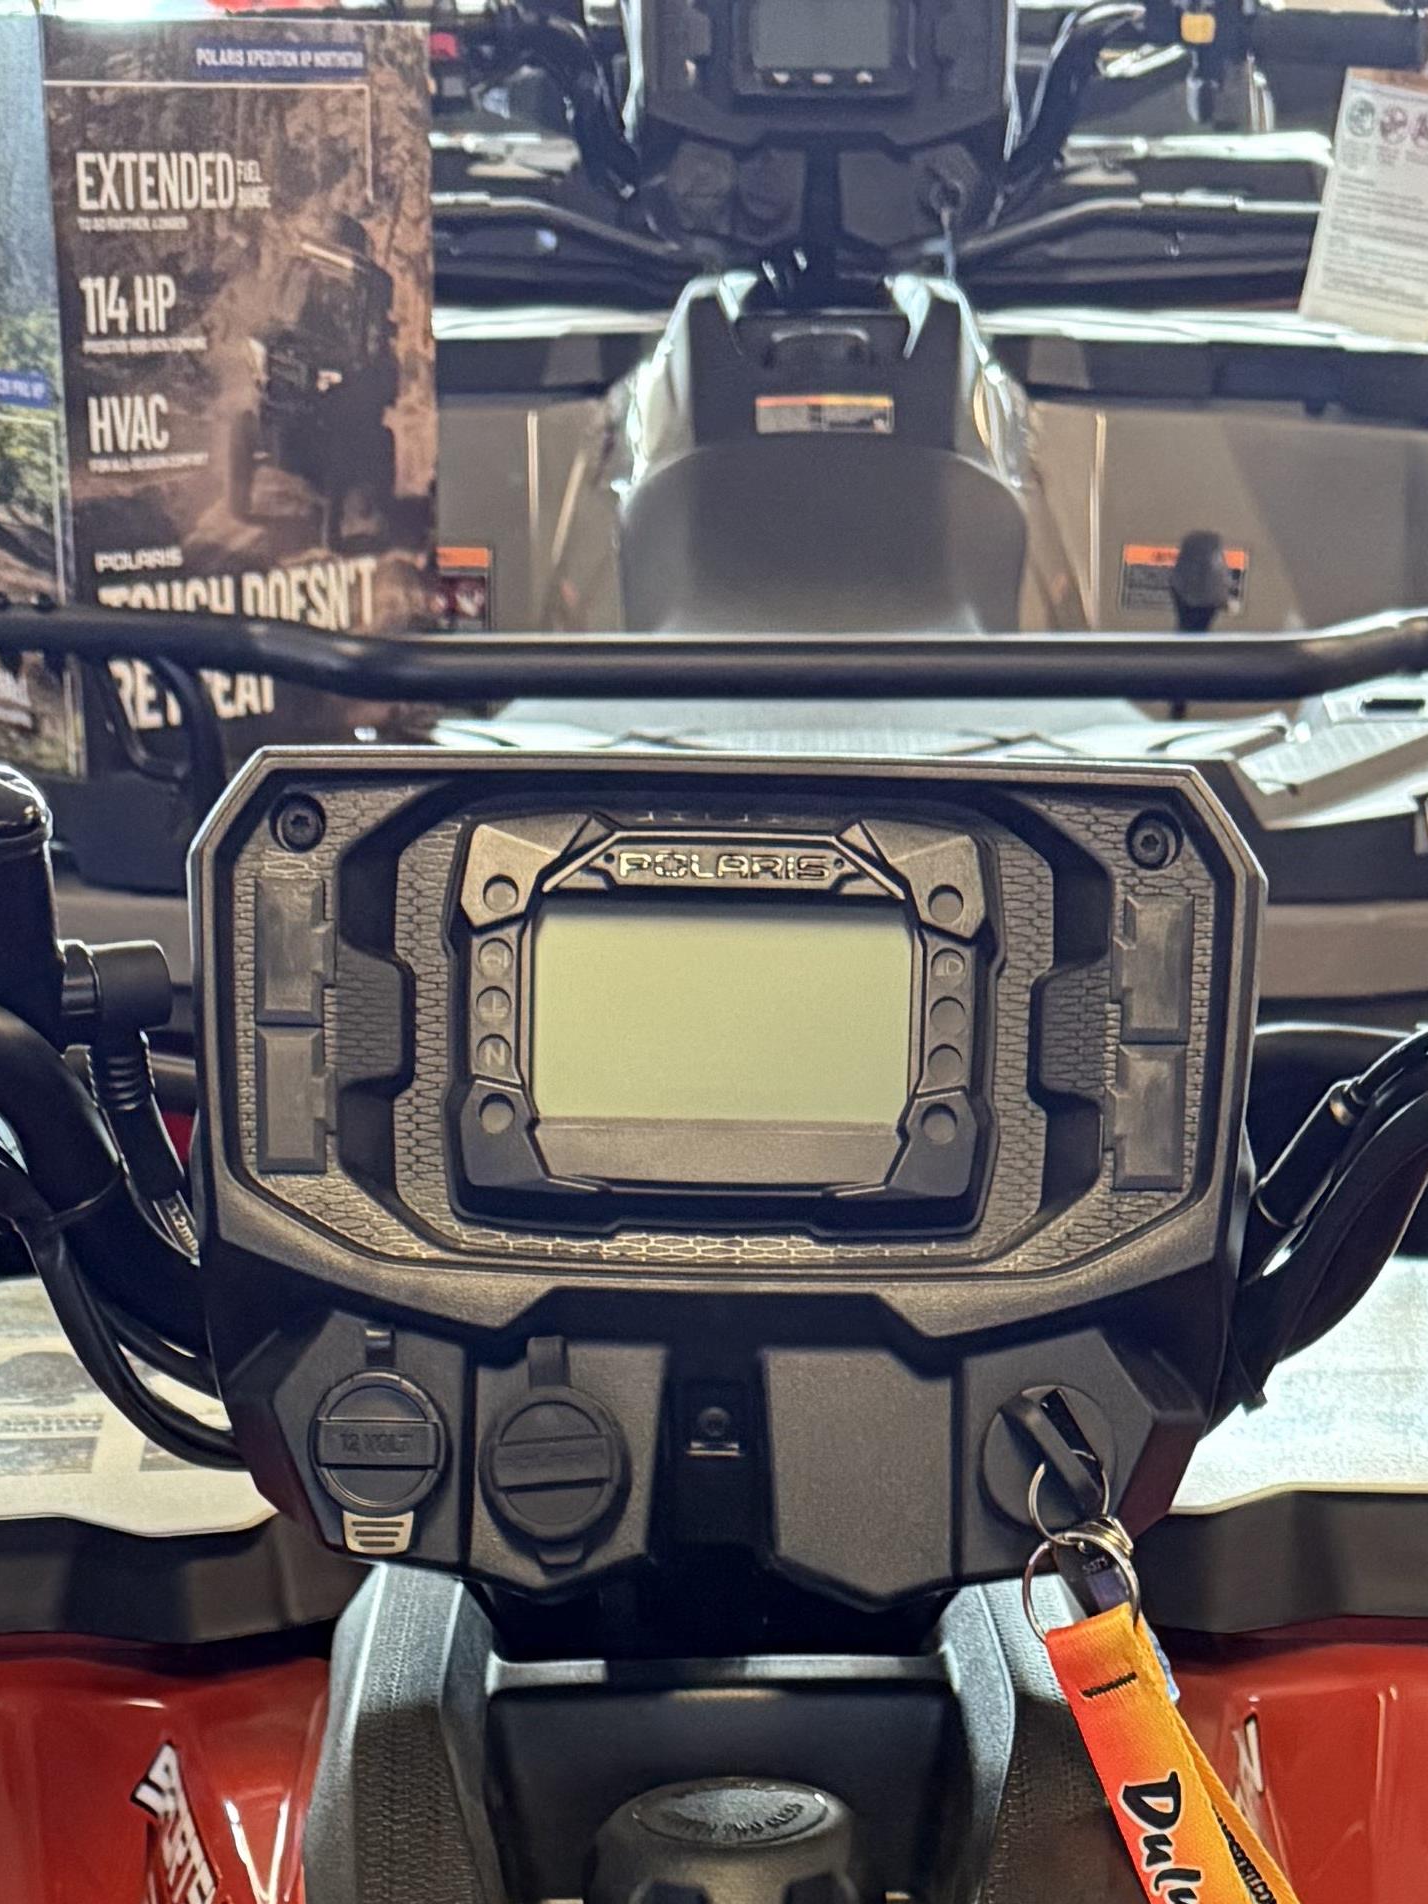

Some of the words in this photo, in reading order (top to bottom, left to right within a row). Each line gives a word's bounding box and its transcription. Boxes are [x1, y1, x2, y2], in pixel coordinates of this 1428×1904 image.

[76, 152, 236, 211] EXTENDED
[79, 275, 128, 334] 114
[134, 275, 176, 332] HP
[88, 394, 169, 453] HVAC
[95, 547, 183, 572] POLARIS
[619, 851, 830, 880] POLARIS
